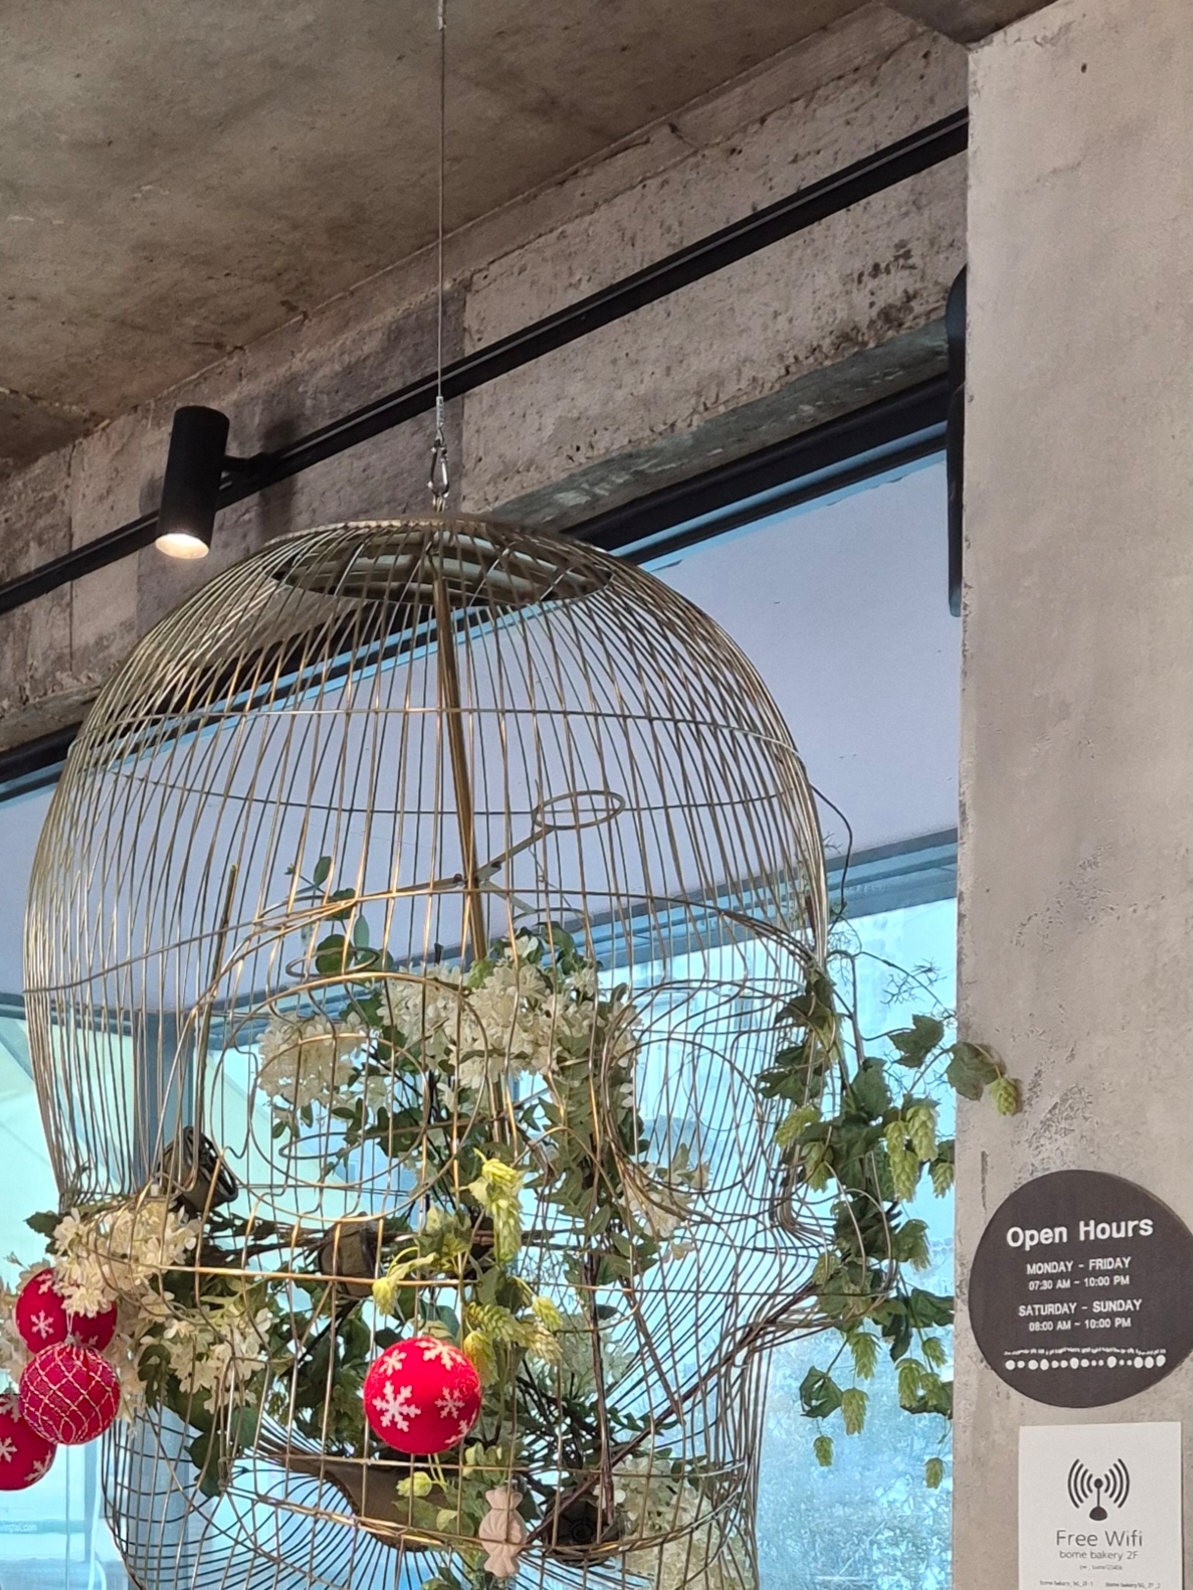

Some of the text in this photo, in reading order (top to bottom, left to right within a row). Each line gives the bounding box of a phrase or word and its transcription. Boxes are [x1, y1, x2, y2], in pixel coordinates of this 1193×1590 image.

[1007, 1218, 1153, 1251] Open Hours
[1026, 1261, 1073, 1275] MONDAY
[1089, 1256, 1131, 1271] FRIDAY
[1028, 1280, 1053, 1290] 07:30
[1056, 1279, 1070, 1289] AM
[1084, 1276, 1110, 1287] 10:00
[1113, 1275, 1130, 1285] PM
[1018, 1302, 1077, 1317] SATURDAY
[1092, 1299, 1142, 1313] SUNDAY
[1029, 1321, 1053, 1332] 08:00
[1056, 1320, 1071, 1330] AM
[1084, 1318, 1111, 1329] 10:00
[1114, 1317, 1131, 1328] PM
[1056, 1529, 1143, 1546] Free Wifi
[1059, 1550, 1139, 1561] bome bakery 2F
